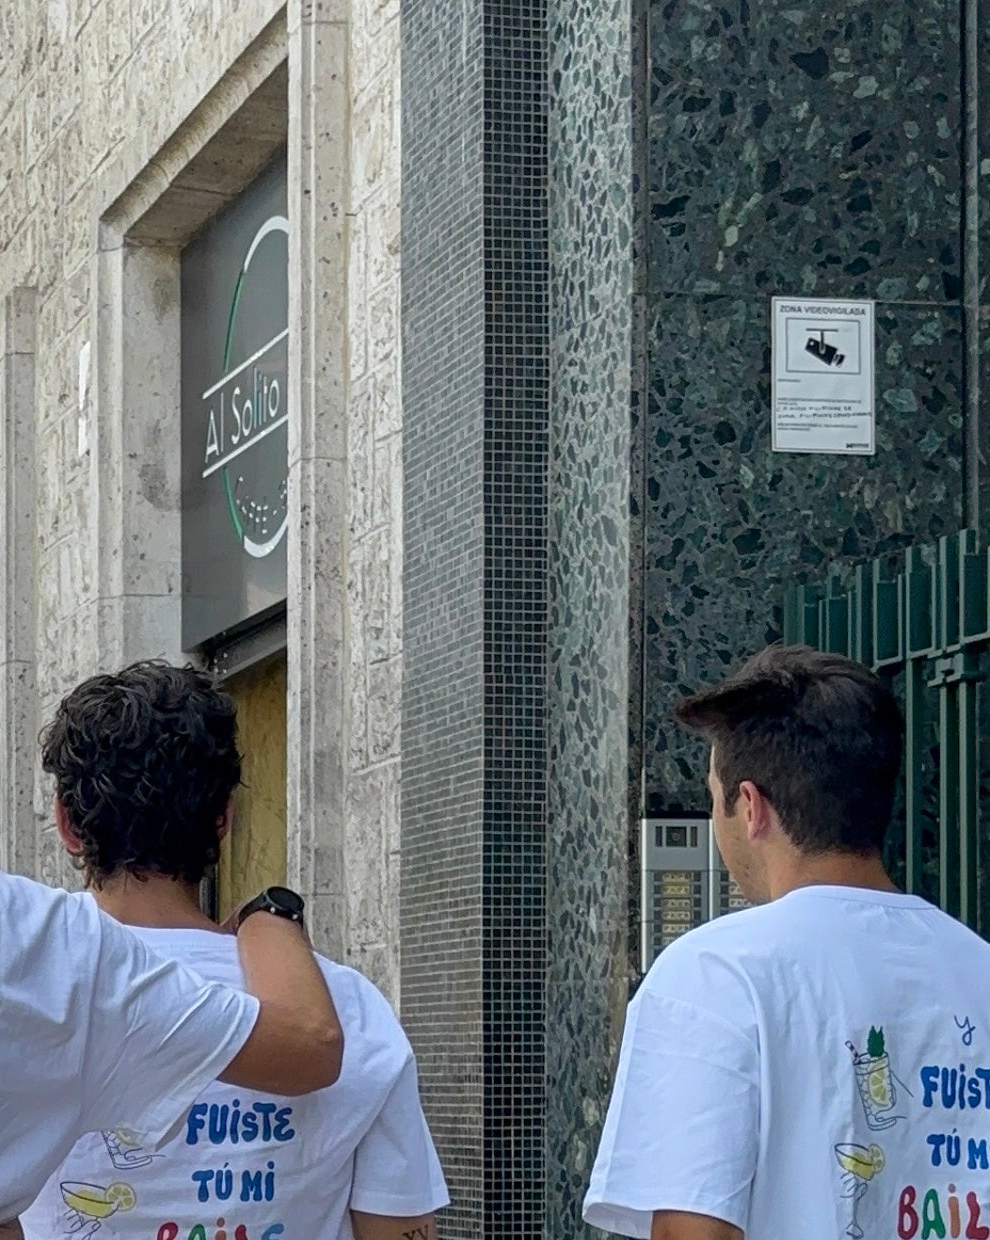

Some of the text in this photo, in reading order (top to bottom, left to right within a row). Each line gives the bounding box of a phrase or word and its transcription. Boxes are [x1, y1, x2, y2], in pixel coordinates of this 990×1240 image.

[779, 304, 867, 316] ZONA VIDEOVIGILADA
[205, 364, 280, 464] Al Solito
[926, 1128, 990, 1170] TÚ M
[191, 1162, 234, 1203] TÚ
